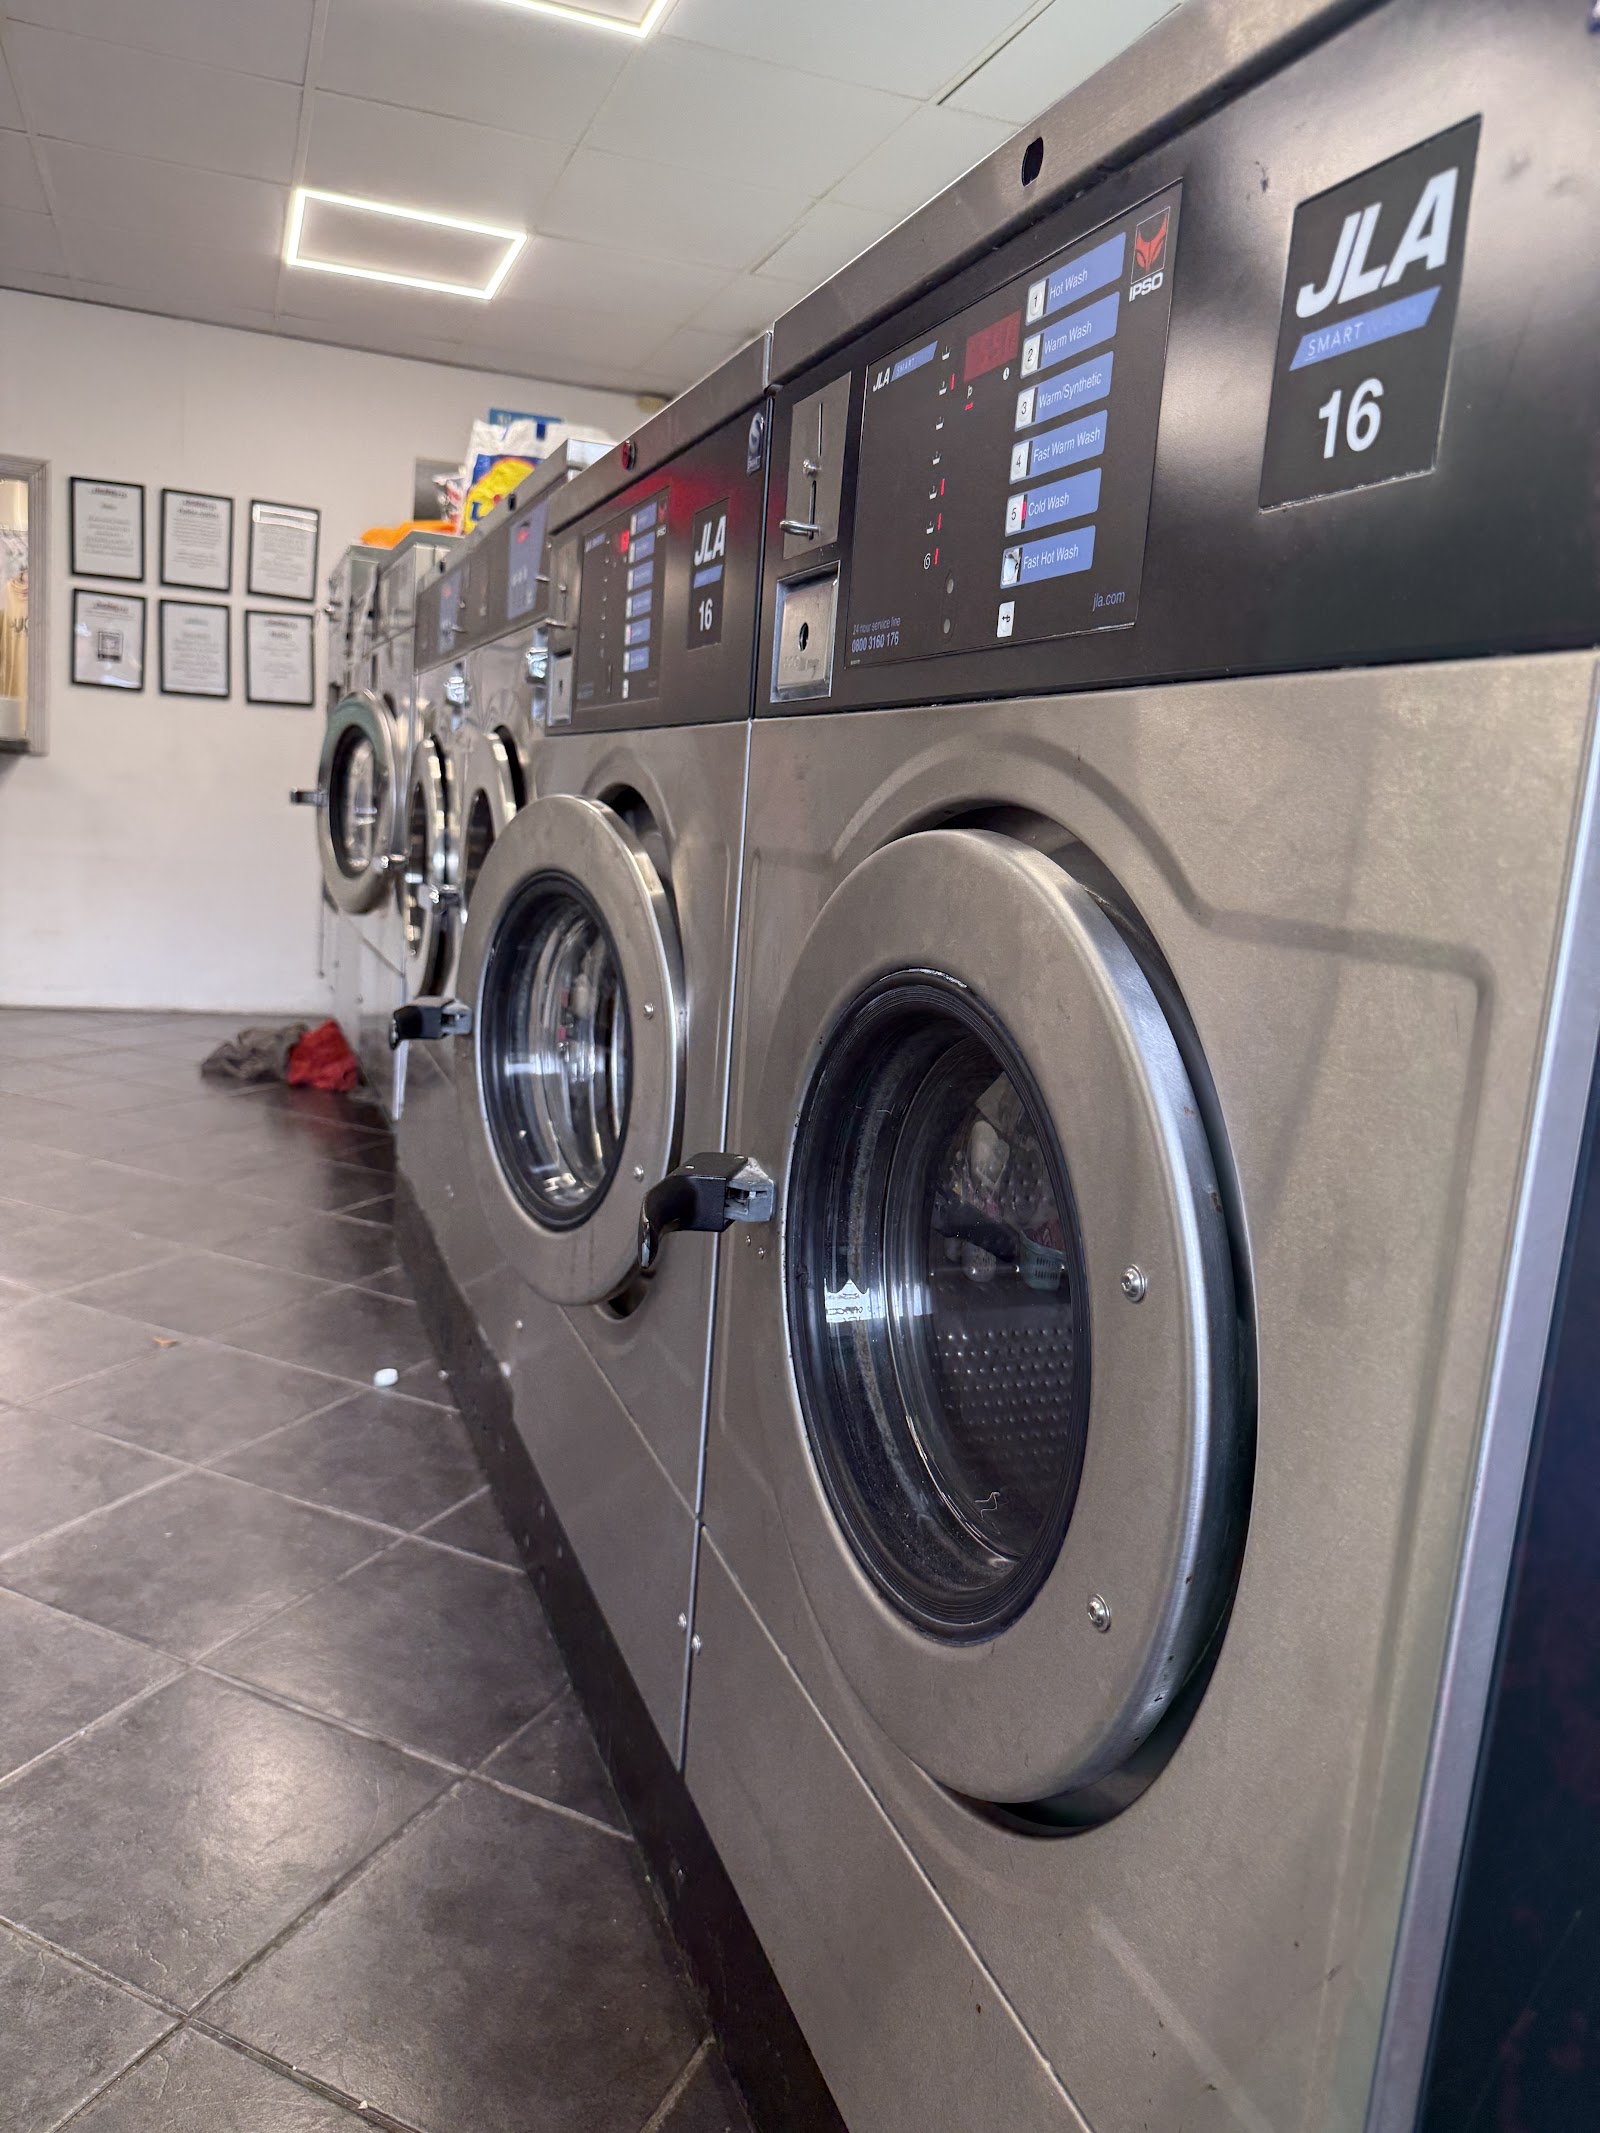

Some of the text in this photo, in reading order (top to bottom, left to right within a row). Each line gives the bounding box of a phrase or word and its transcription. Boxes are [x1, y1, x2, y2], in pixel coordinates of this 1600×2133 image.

[1296, 166, 1458, 318] JLA
[1050, 281, 1063, 300] Hot
[1065, 268, 1088, 291] Wash
[1129, 272, 1163, 302] IPSO
[1027, 321, 1092, 362] 2 Warm Wash
[873, 366, 890, 392] JLA
[1021, 371, 1102, 415] 3 Warm/Synthetic
[1318, 378, 1384, 459] 16
[1016, 427, 1101, 467] 4 Fast Warm Wash
[1011, 492, 1070, 521] 5 Cold Wash
[694, 514, 727, 567] JLA
[1023, 544, 1079, 570] Fast Hot Wash
[698, 598, 713, 632] 16
[1092, 591, 1125, 612] jla.com
[871, 618, 891, 632] service
[851, 631, 900, 653] 0800 3160 176
